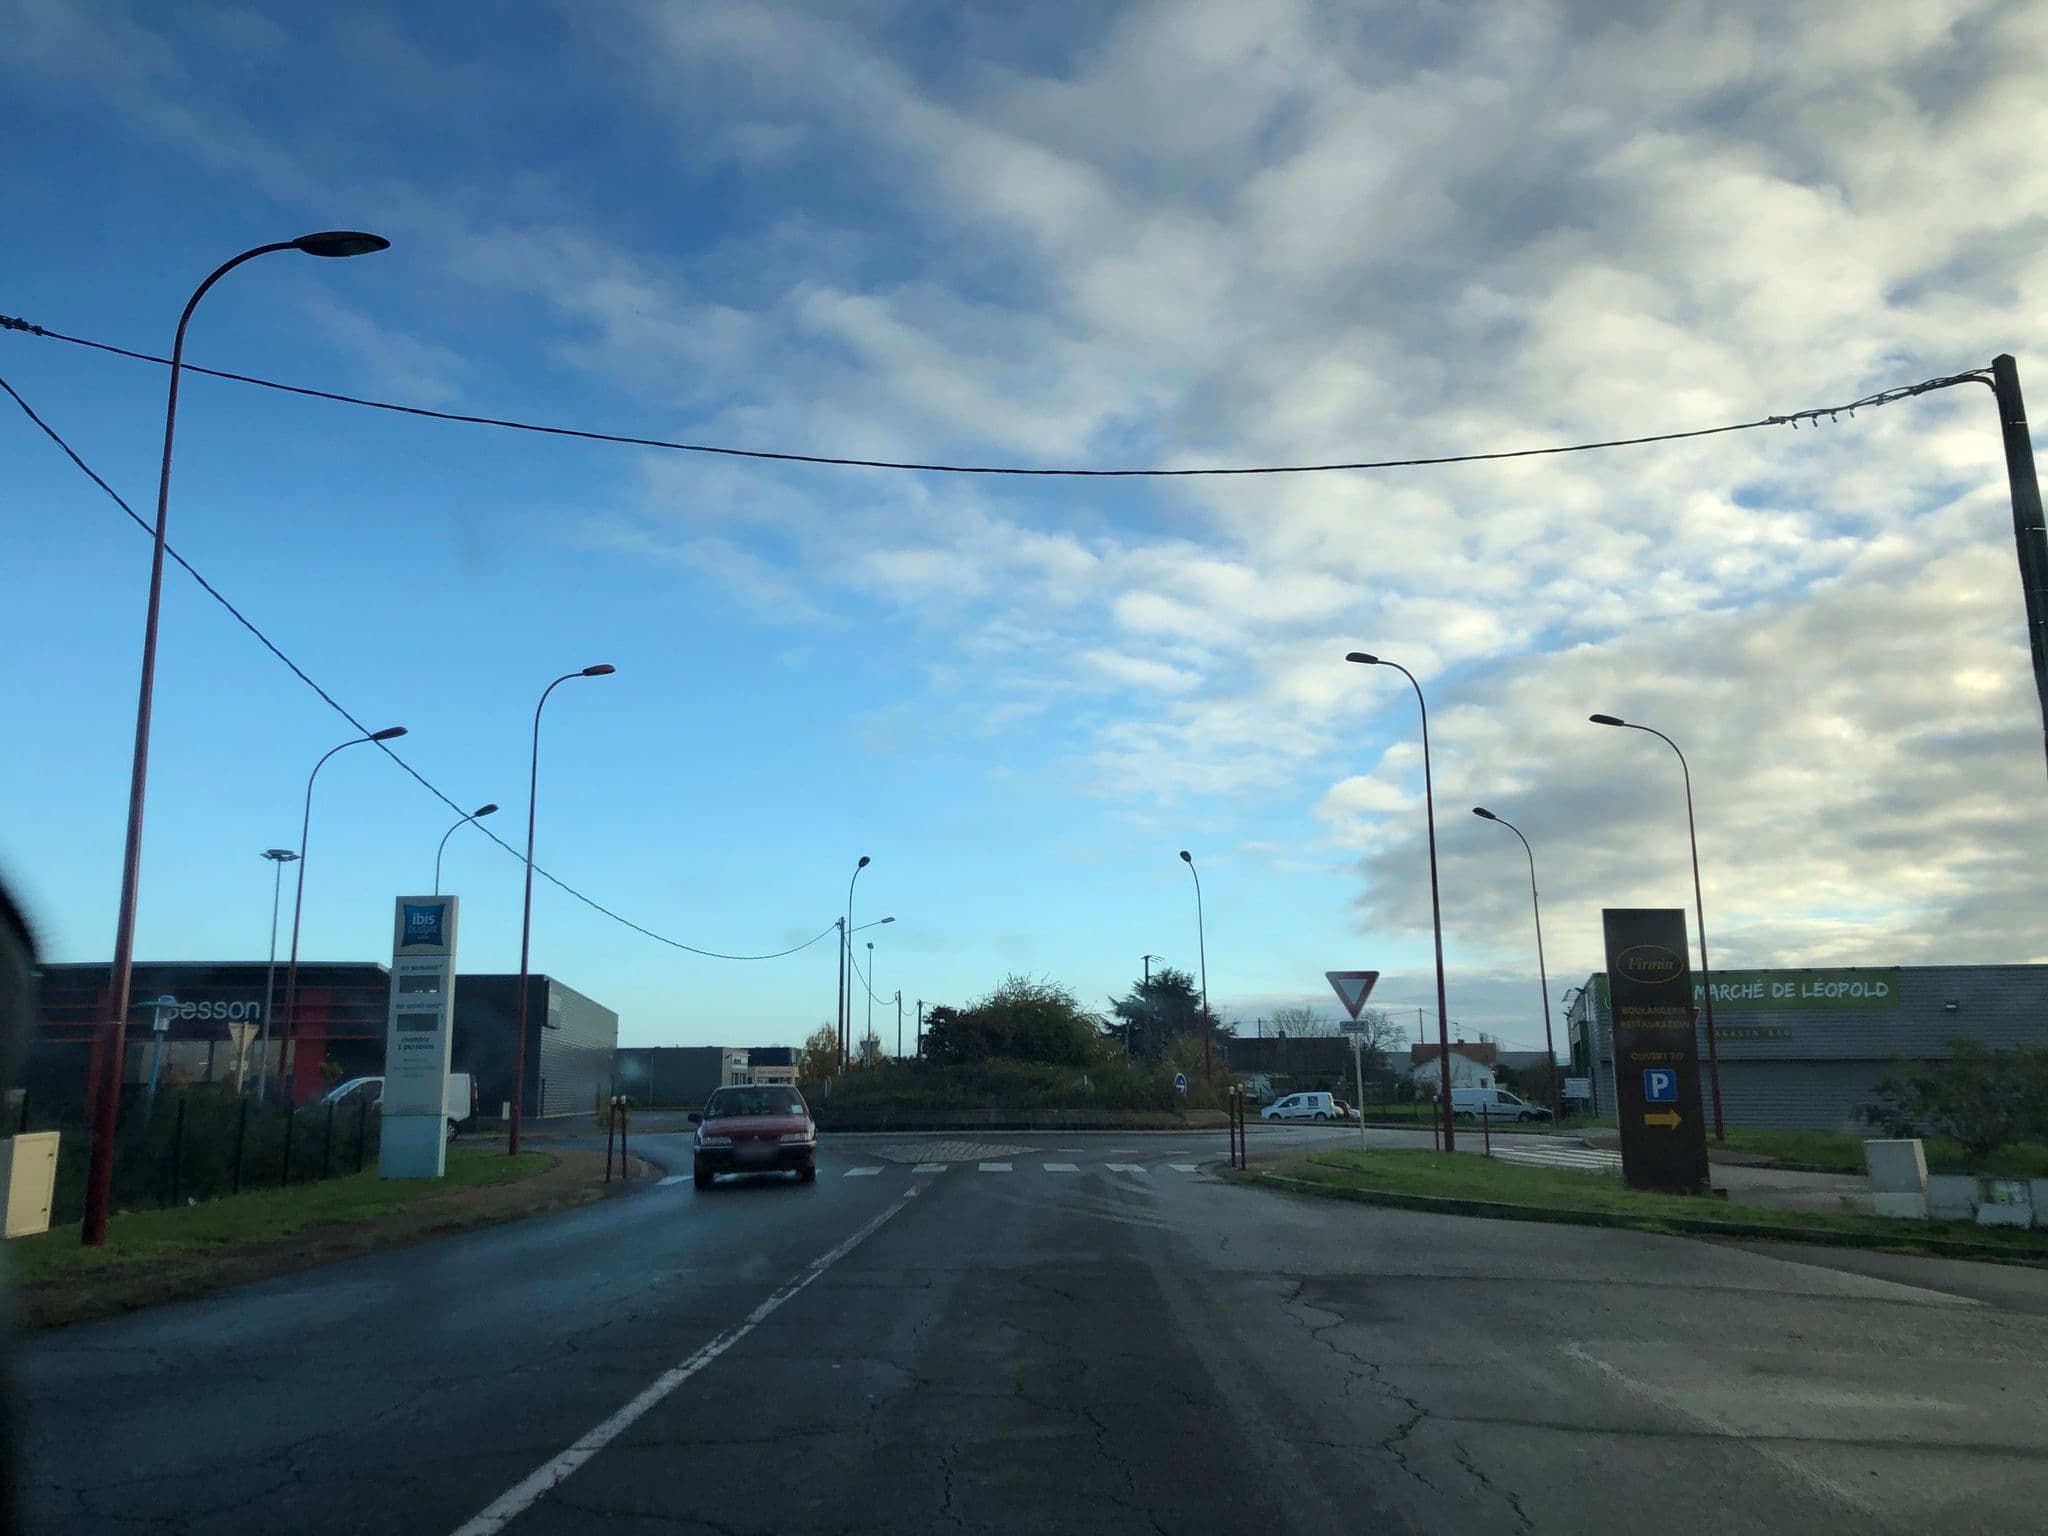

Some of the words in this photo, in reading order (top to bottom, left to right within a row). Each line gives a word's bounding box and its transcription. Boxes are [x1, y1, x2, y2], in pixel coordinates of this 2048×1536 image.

[412, 911, 436, 925] ibis
[1694, 979, 1764, 1001] MARCHÉ
[1771, 982, 1796, 998] DE
[1802, 979, 1889, 999] LÉOPOLD
[1651, 1072, 1669, 1098] P
